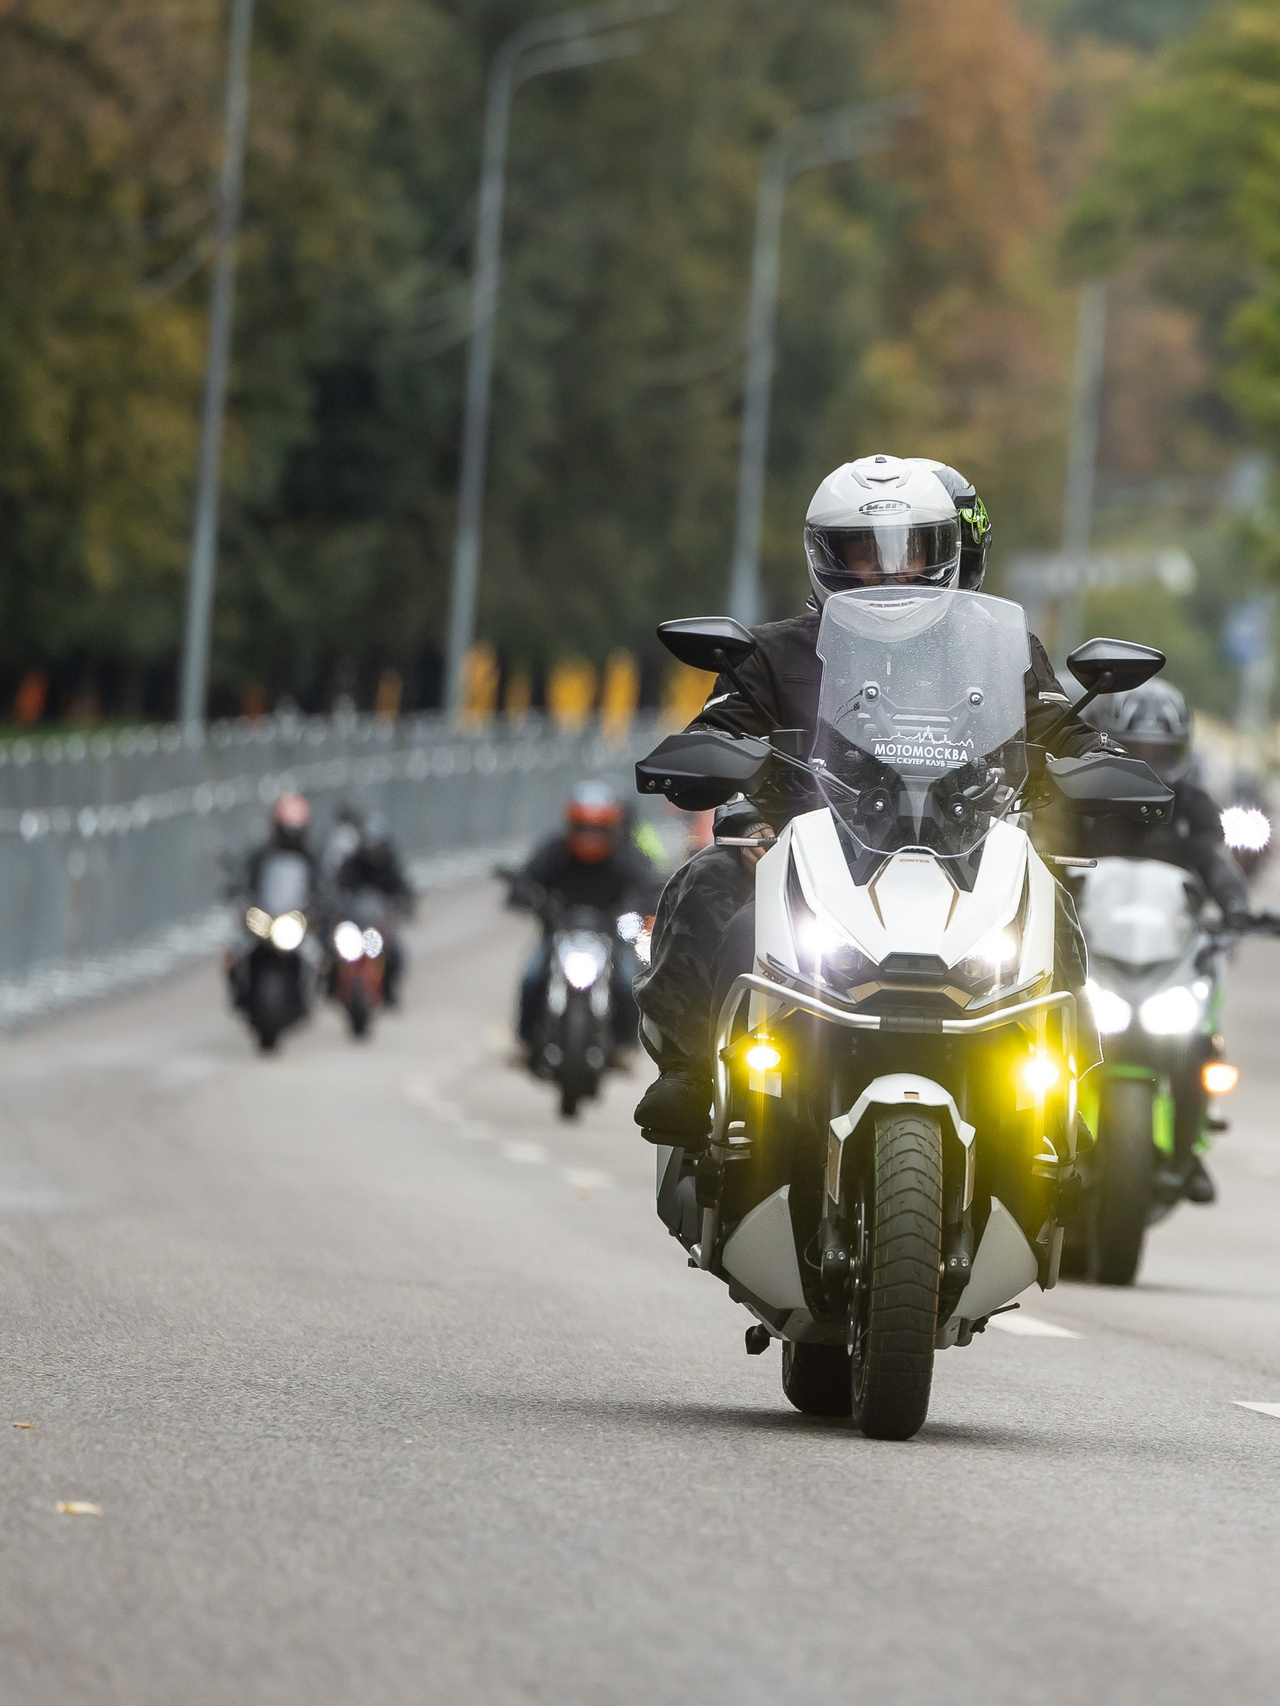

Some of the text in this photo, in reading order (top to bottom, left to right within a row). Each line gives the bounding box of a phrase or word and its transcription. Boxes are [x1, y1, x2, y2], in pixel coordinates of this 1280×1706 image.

[874, 743, 968, 761] МОТОМОСКВА
[896, 757, 946, 767] СКУТЕР КЛУБ
